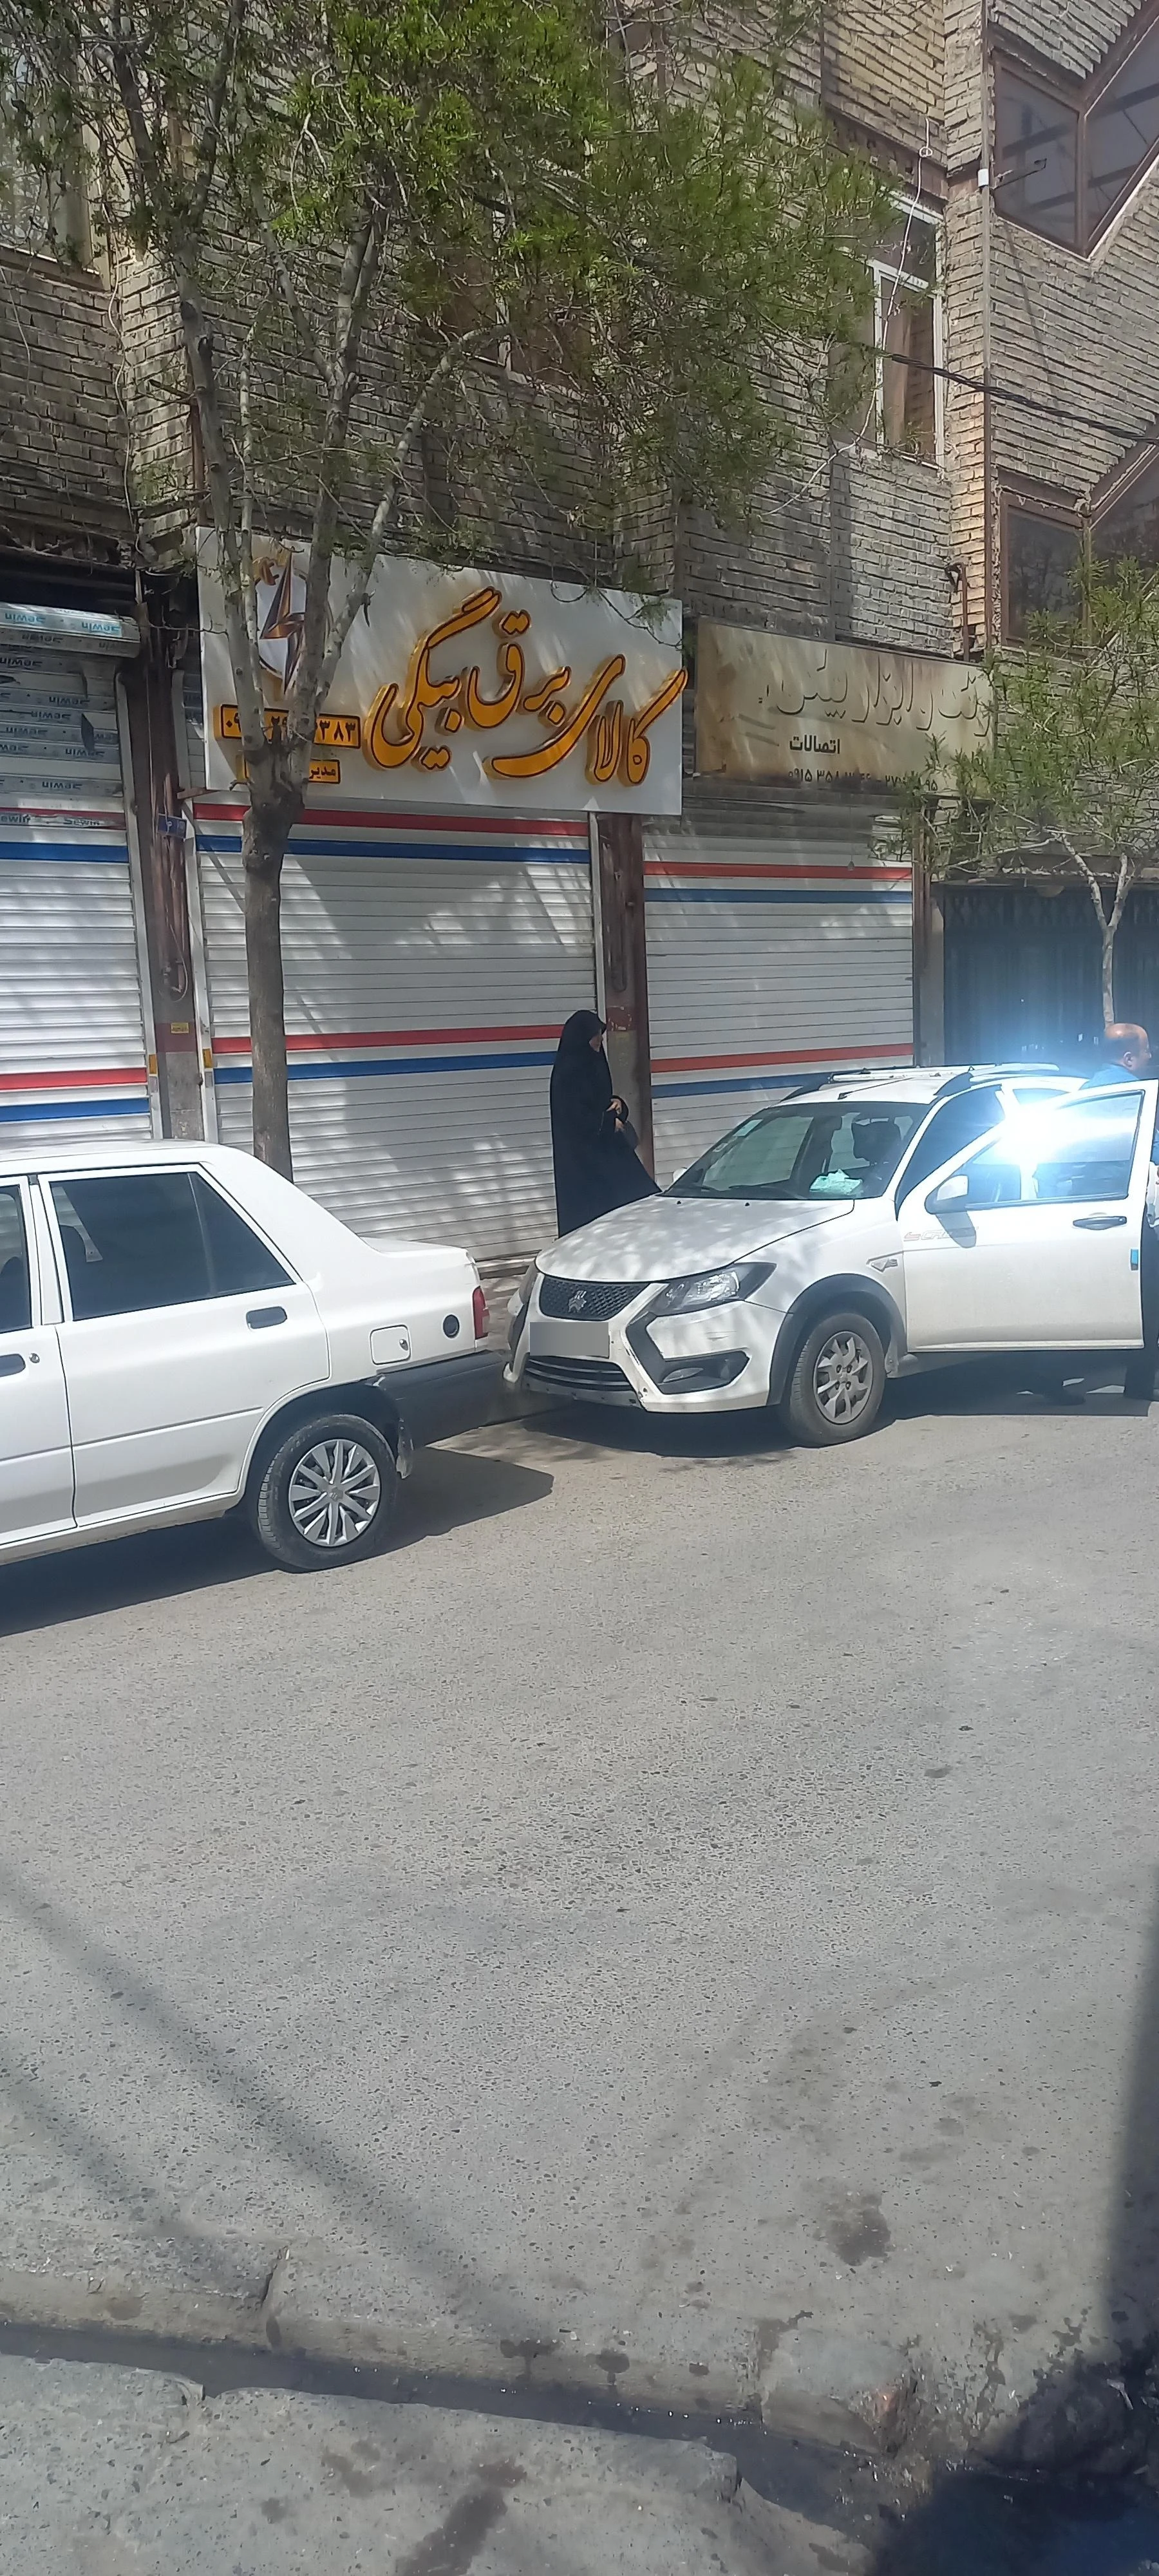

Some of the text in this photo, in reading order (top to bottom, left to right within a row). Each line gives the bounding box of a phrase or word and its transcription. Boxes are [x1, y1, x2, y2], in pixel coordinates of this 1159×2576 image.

[465, 608, 572, 730] برق
[484, 654, 687, 786] کالای
[789, 734, 840, 755] اتصالات
